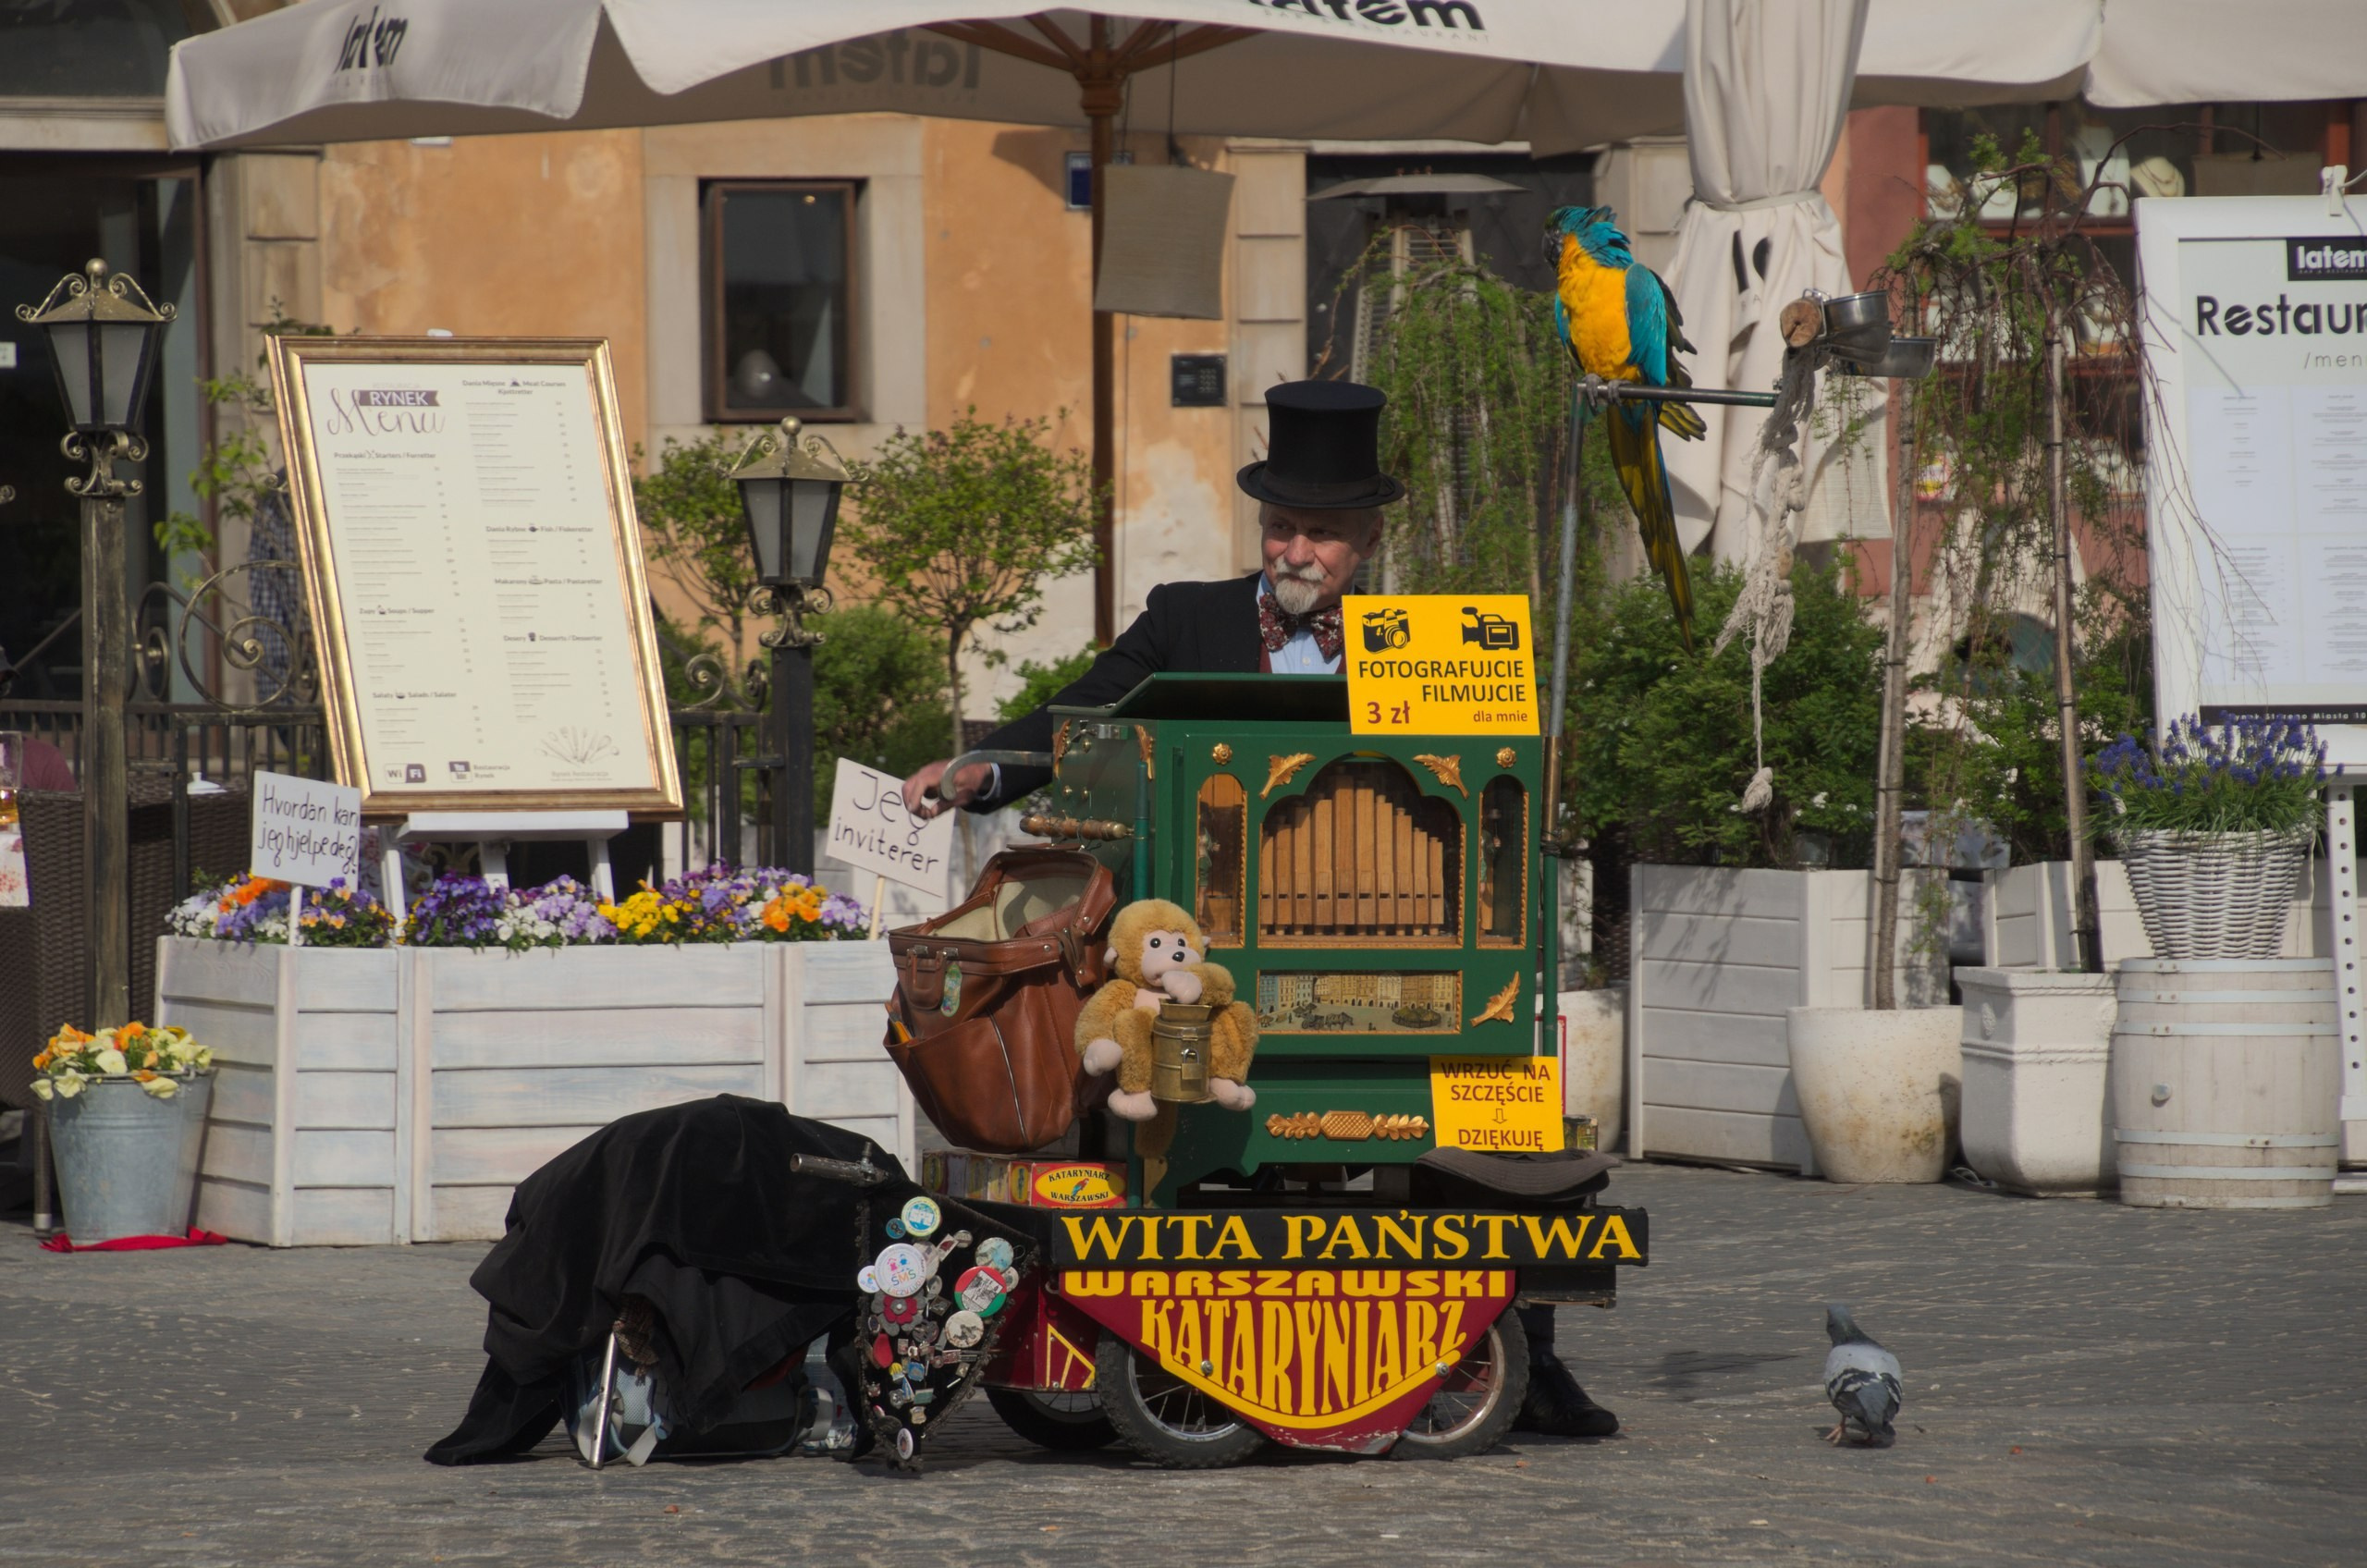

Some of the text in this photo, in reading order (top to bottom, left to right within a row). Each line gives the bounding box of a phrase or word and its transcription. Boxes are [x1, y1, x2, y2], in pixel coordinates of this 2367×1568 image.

[1248, 0, 1486, 31] tem
[369, 391, 429, 406] RYNEK
[326, 387, 446, 436] Menu
[1358, 660, 1525, 679] FOTOGRAFUJCIE
[1422, 684, 1527, 703] FILMUJCIE
[1367, 700, 1411, 725] 3 zł
[1473, 709, 1528, 723] dla mnie
[2313, 712, 2349, 720] Miasta
[263, 783, 359, 827] Hvordan kan
[257, 821, 285, 867] jeg
[835, 816, 939, 874] inviterer
[1441, 1059, 1551, 1081] WRZUĆ NA
[1451, 1082, 1545, 1106] SZCZĘŚCIE
[1458, 1129, 1544, 1151] DZIĘKUJĘ
[1049, 1169, 1110, 1182] KATARYNIARZ
[1050, 1191, 1110, 1203] WARSZAWSKI
[1061, 1208, 1643, 1260] WITA PAŃSTWA
[890, 1268, 917, 1287] SMS
[1064, 1269, 1507, 1298] WARSZAWSKI
[1140, 1299, 1467, 1416] KATARYNIARZ
